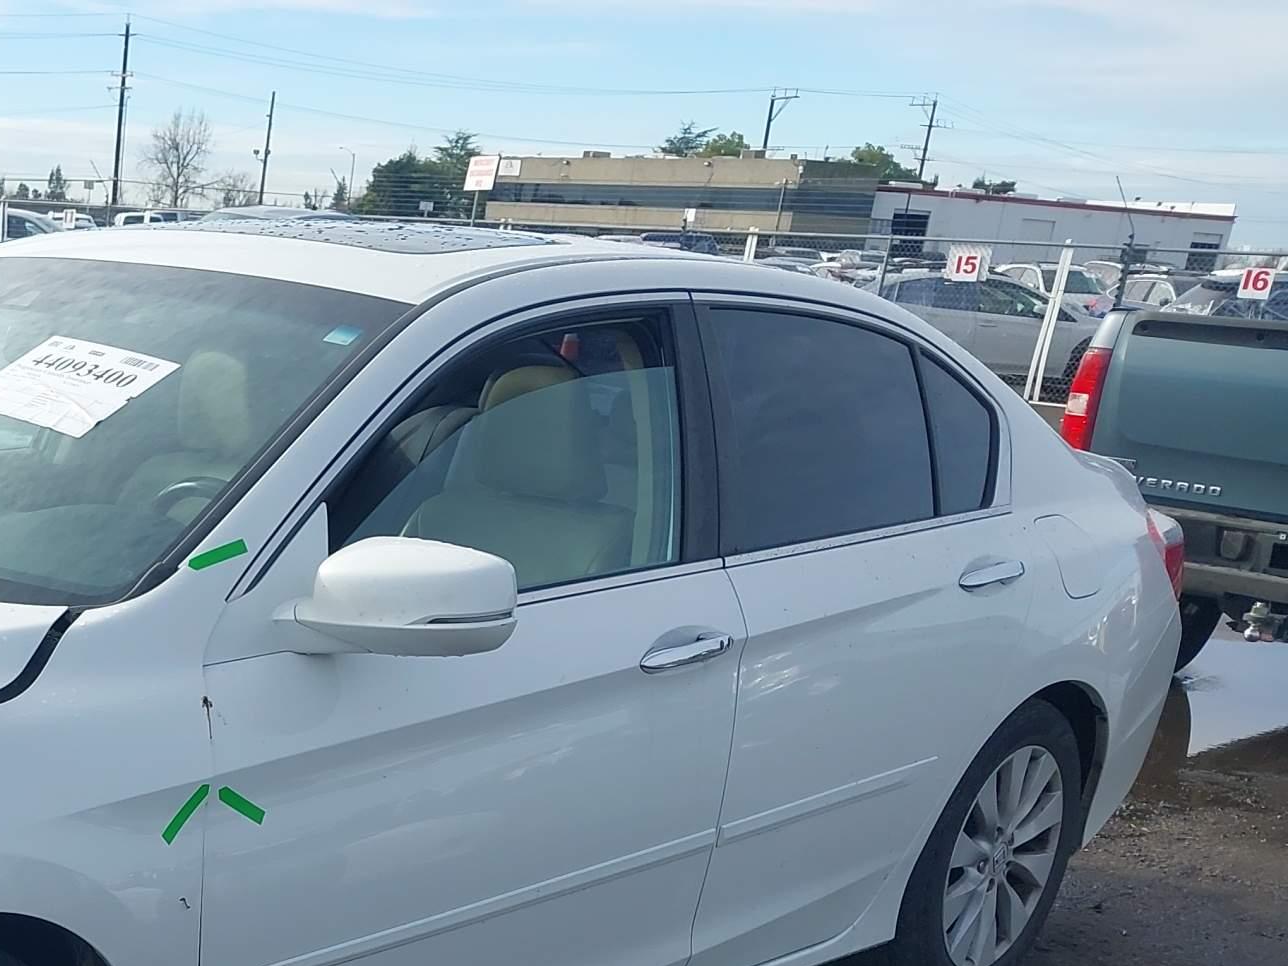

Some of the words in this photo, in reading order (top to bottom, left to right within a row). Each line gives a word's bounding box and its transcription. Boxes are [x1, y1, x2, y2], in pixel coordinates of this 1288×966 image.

[955, 255, 978, 274] 15
[1242, 269, 1271, 291] 16
[32, 353, 138, 388] 44093400
